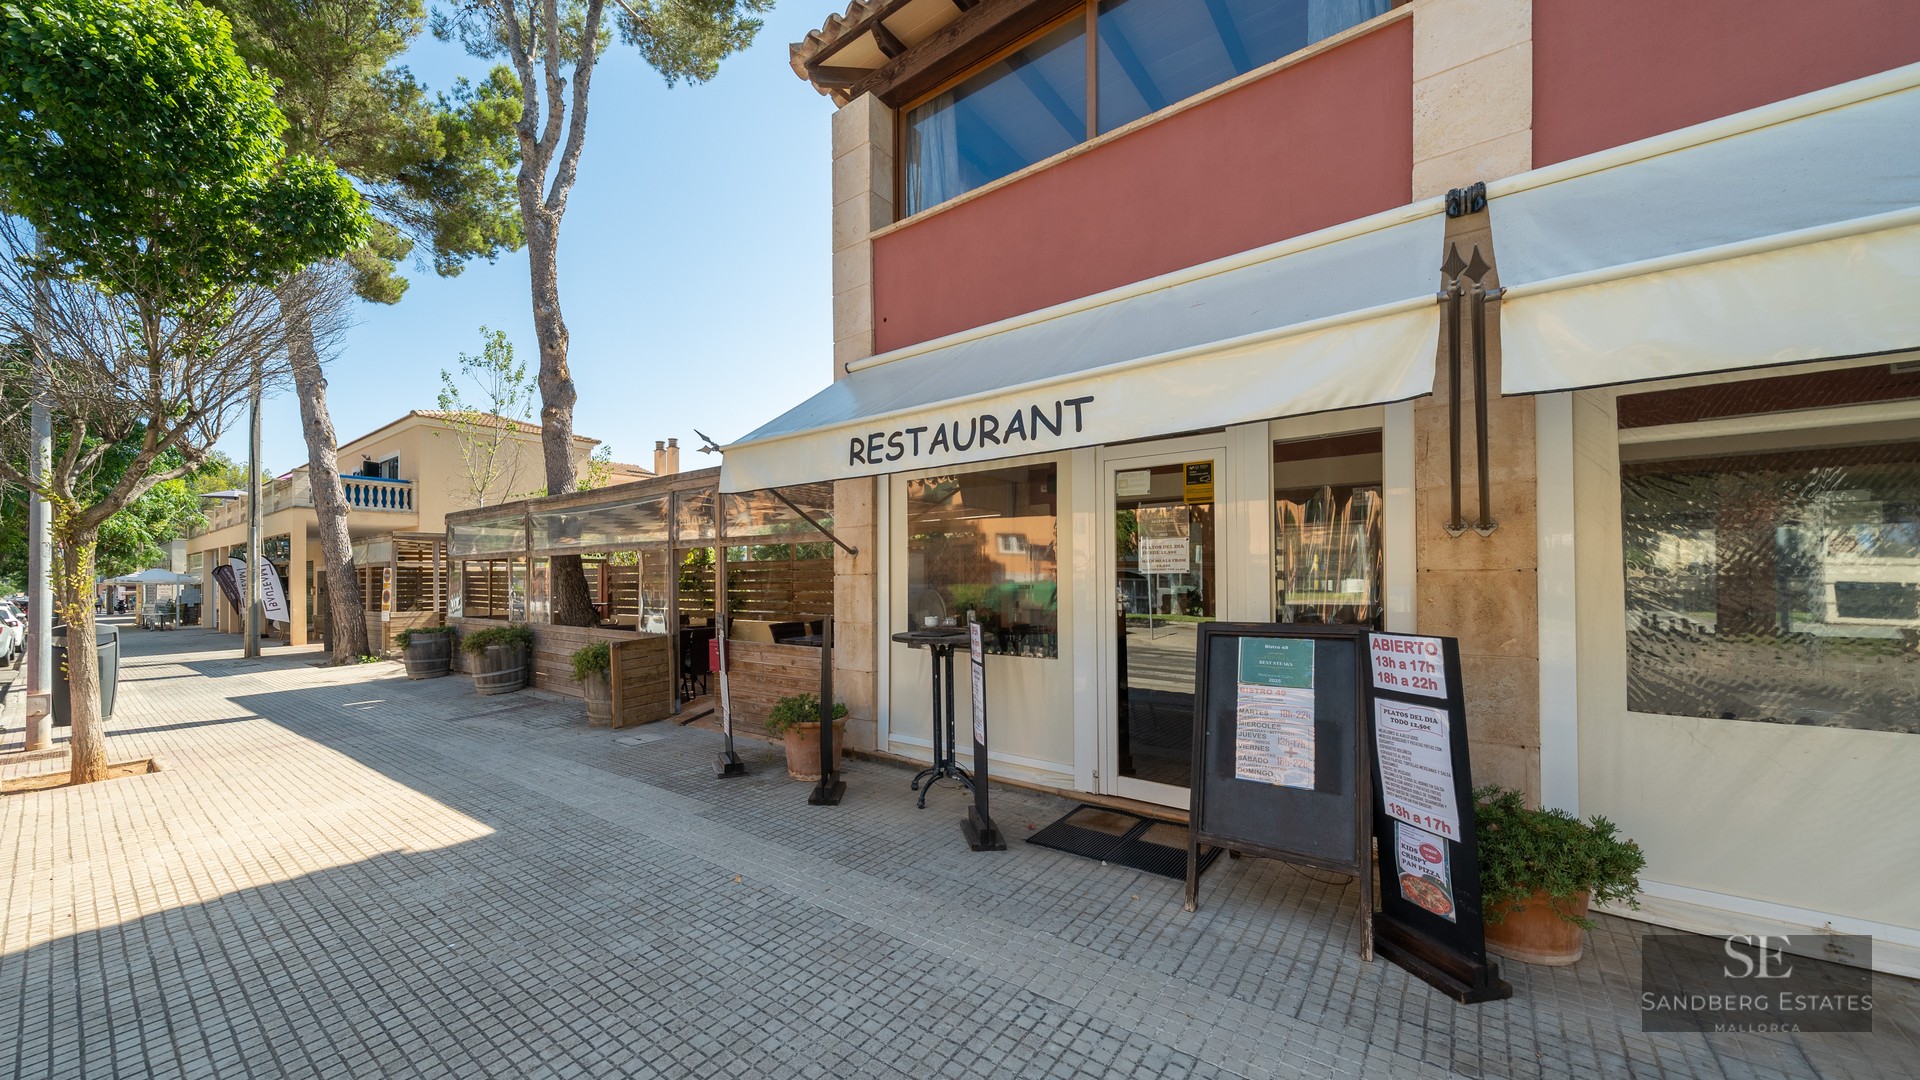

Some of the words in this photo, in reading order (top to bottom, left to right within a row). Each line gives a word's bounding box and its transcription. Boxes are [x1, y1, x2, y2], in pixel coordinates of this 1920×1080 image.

[850, 396, 1094, 466] RESTAURANT
[1372, 637, 1438, 656] ABIERTO
[1376, 655, 1396, 668] 13h
[1399, 661, 1407, 670] a
[1410, 660, 1435, 673] 17h
[1378, 671, 1398, 685] 18h
[1401, 677, 1409, 686] a
[1412, 676, 1438, 690] 22h
[1240, 686, 1273, 695] BISTRO
[1239, 708, 1269, 716] MARTES
[1384, 708, 1409, 718] PLATOS
[1410, 713, 1423, 722] DEL
[1424, 716, 1438, 724] DIA
[1390, 717, 1408, 726] TODO
[1238, 731, 1267, 740] JUEVES
[1238, 743, 1270, 752] VIERNES
[1238, 766, 1273, 776] DOMINGO
[1389, 802, 1410, 820] 13h
[1413, 813, 1421, 824] a
[1424, 816, 1451, 834] 17h
[1401, 843, 1418, 854] KIDS
[1401, 851, 1427, 865] CRISPY
[1402, 858, 1416, 869] PAN
[1418, 865, 1441, 879] PIZZA
